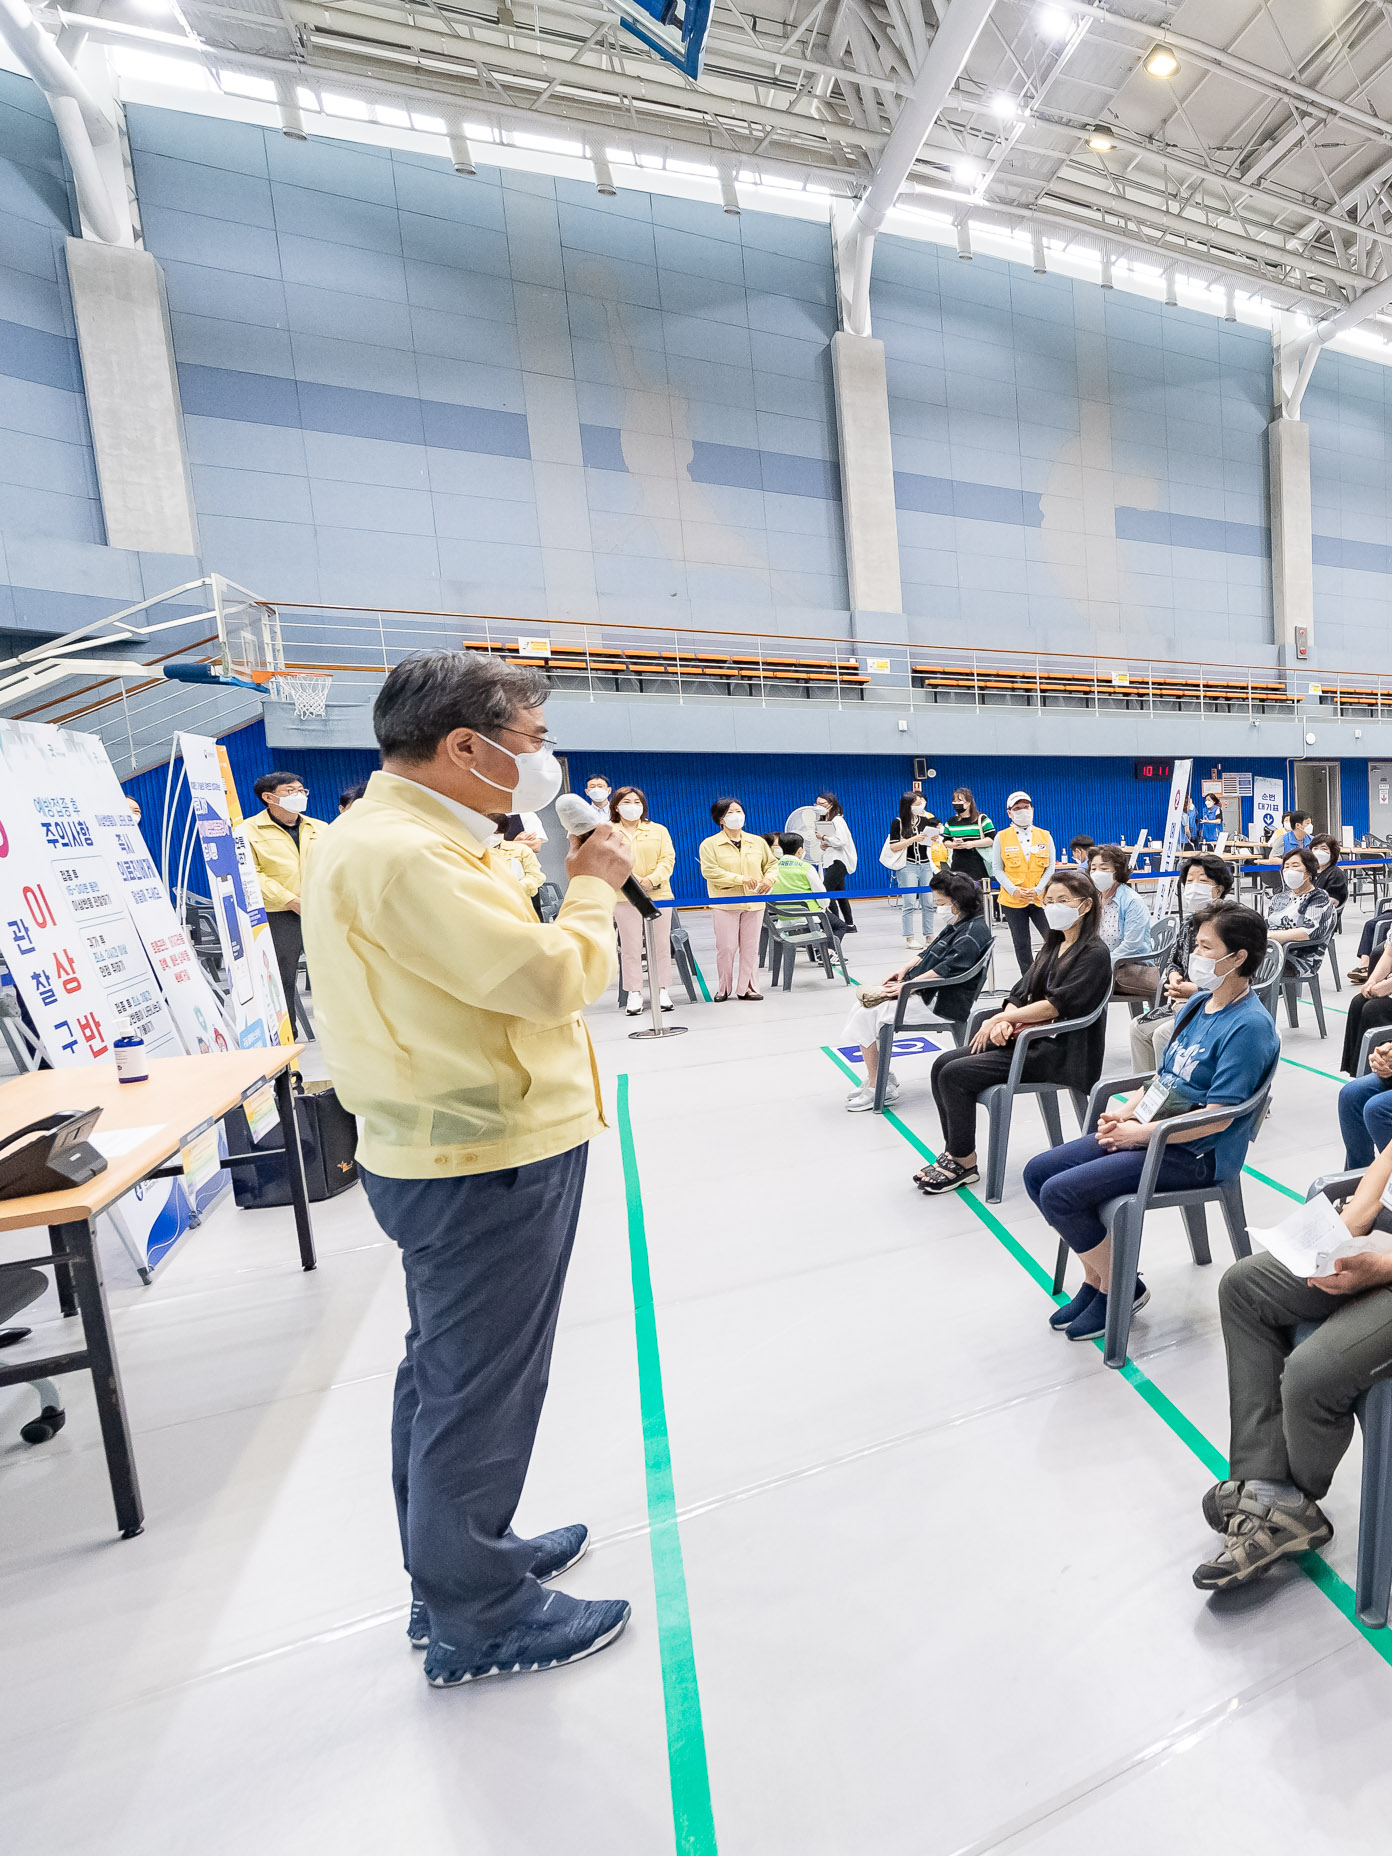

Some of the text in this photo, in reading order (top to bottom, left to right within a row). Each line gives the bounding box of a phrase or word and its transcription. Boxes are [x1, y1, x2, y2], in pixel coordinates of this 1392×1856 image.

[1143, 765, 1169, 776] 10 11
[1262, 793, 1275, 801] 순번
[33, 797, 80, 817] 예방접종 후
[1258, 803, 1279, 811] 대기표
[41, 820, 94, 848] 주의사항
